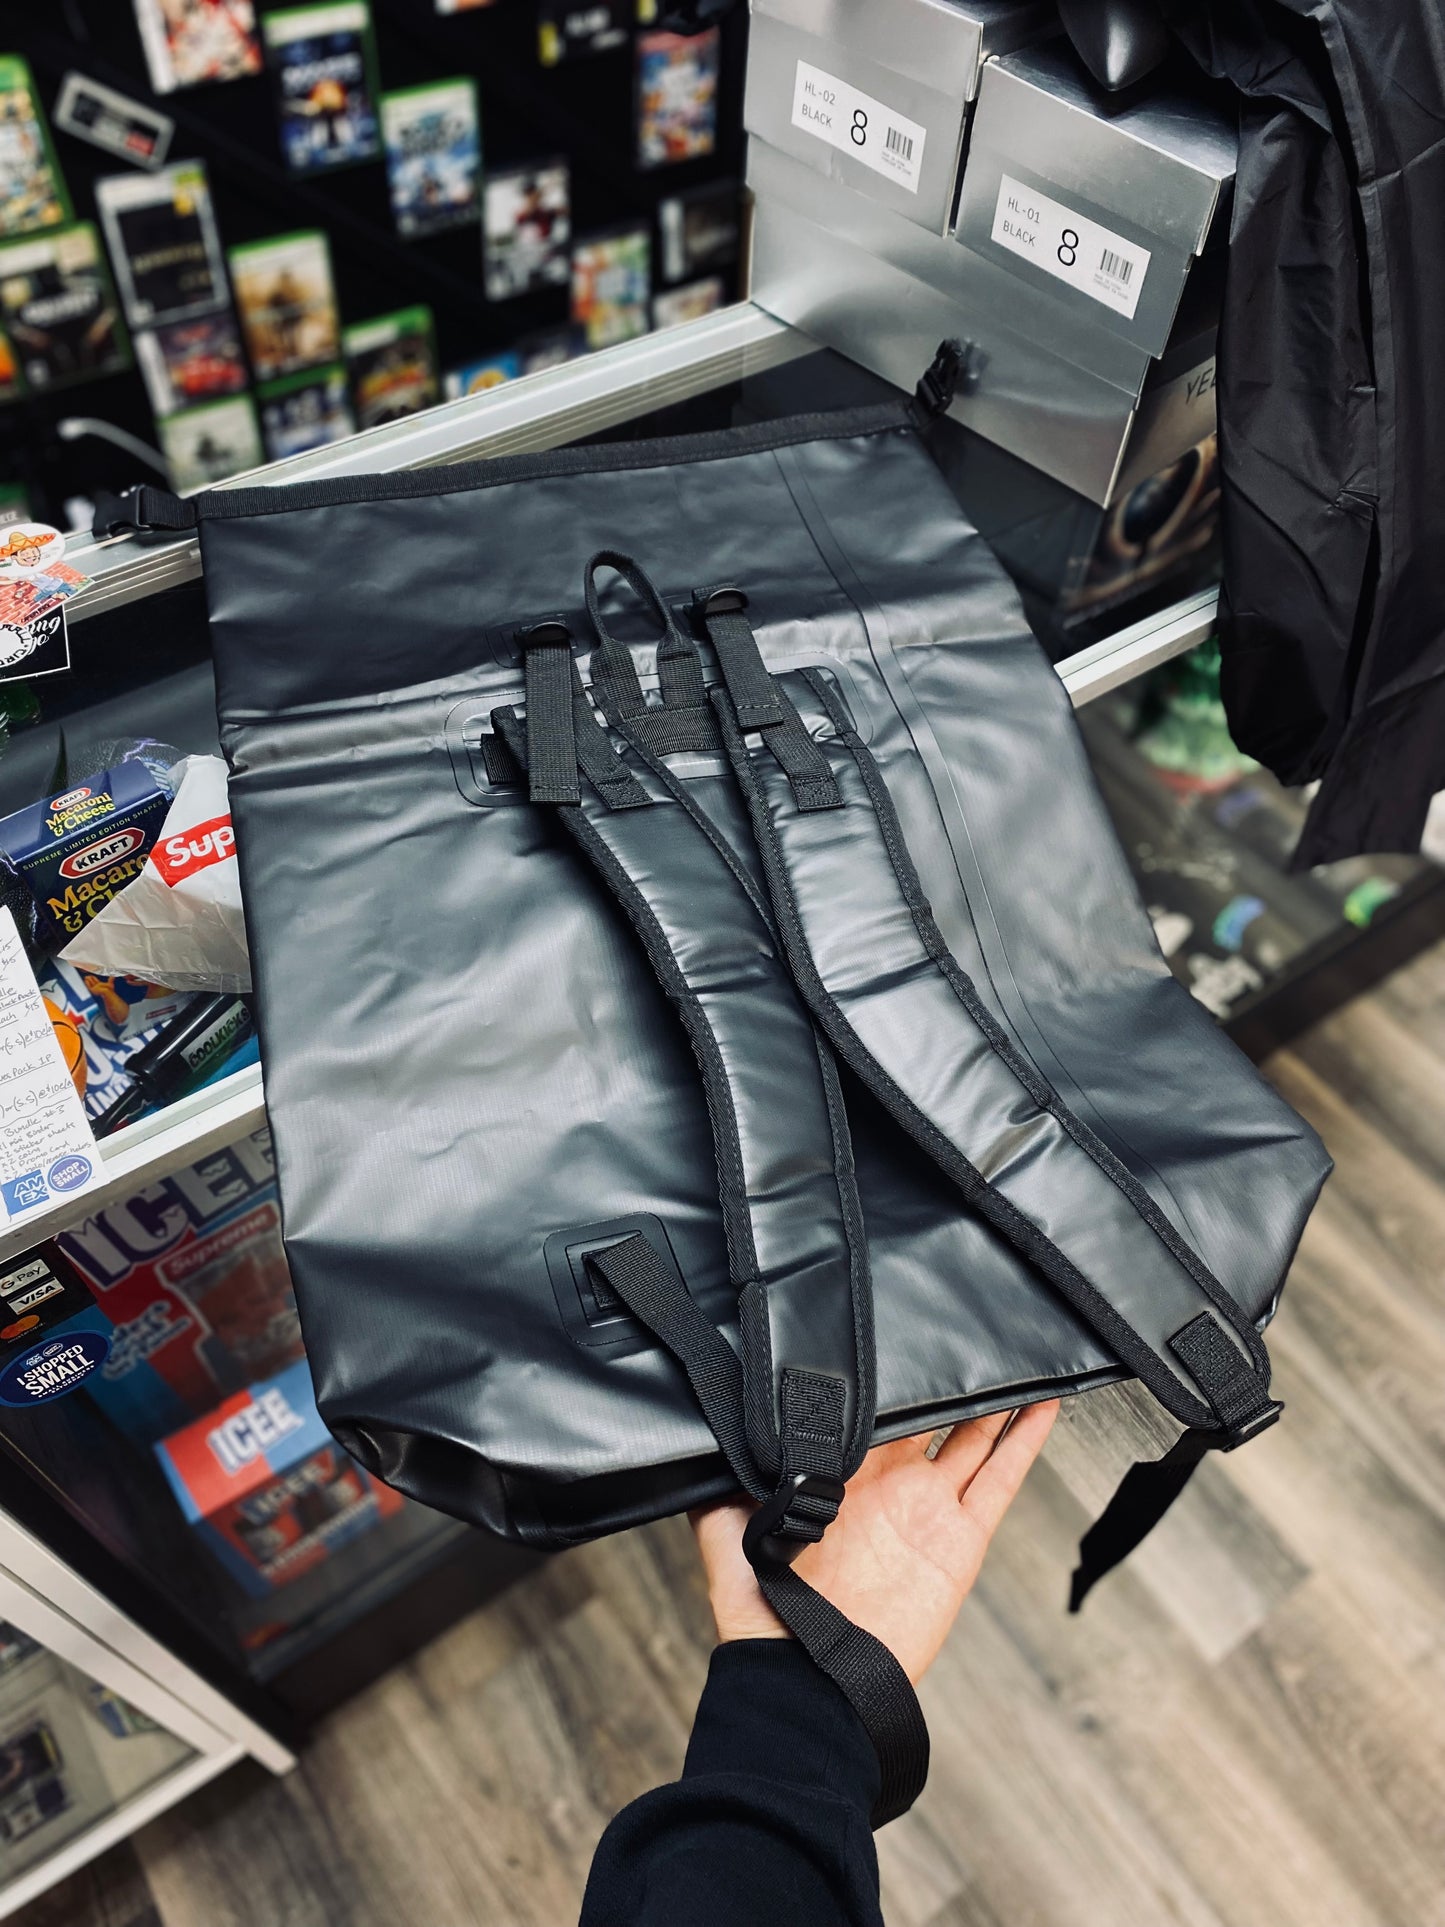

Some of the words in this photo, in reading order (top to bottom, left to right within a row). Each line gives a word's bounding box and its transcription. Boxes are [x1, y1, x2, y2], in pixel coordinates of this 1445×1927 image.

[804, 81, 836, 105] HL-02
[801, 103, 832, 128] BLACK
[850, 108, 868, 146] 8
[1007, 196, 1040, 224] HL-01
[1003, 219, 1036, 247] BLACK
[1057, 228, 1079, 267] 8
[45, 793, 113, 830] Macaroni
[57, 792, 85, 807] KRAFT
[53, 825, 64, 837] &
[63, 801, 116, 830] Cheese
[22, 850, 62, 871] SUPREME
[64, 832, 97, 853] LIMITED
[99, 817, 131, 837] EDITION
[133, 800, 163, 820] SHAPES
[76, 836, 129, 870] KRAFT
[47, 852, 150, 920] Macaro
[63, 911, 83, 933] &
[13, 1173, 45, 1198] AM
[52, 1161, 80, 1182] SHOP
[56, 1165, 89, 1188] SMALL
[20, 1186, 48, 1206] EX
[16, 1266, 41, 1283] Pay
[18, 1285, 56, 1305] VISA
[16, 1377, 25, 1386] I
[24, 1344, 84, 1382] SHOPPED
[25, 1354, 94, 1396] SMALL
[206, 1387, 306, 1478] ICEE
